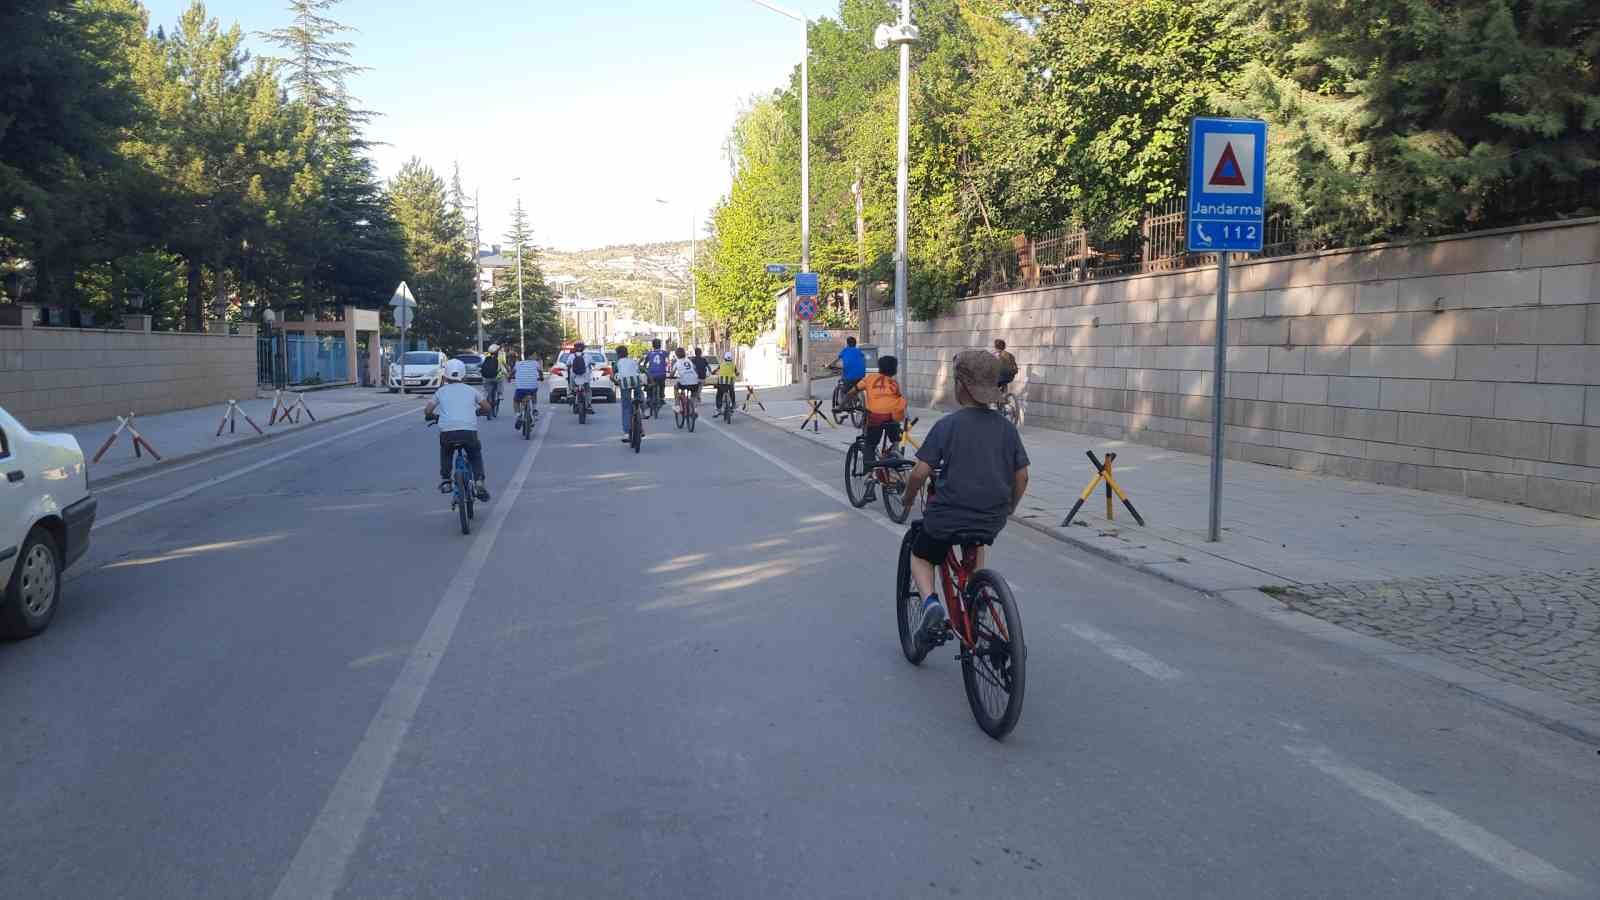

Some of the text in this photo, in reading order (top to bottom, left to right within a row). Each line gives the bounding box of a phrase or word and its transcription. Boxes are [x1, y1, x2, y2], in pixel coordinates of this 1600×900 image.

[1193, 202, 1262, 216] Jandarma
[1224, 225, 1256, 240] 112
[653, 354, 661, 365] 4
[683, 361, 692, 370] 9
